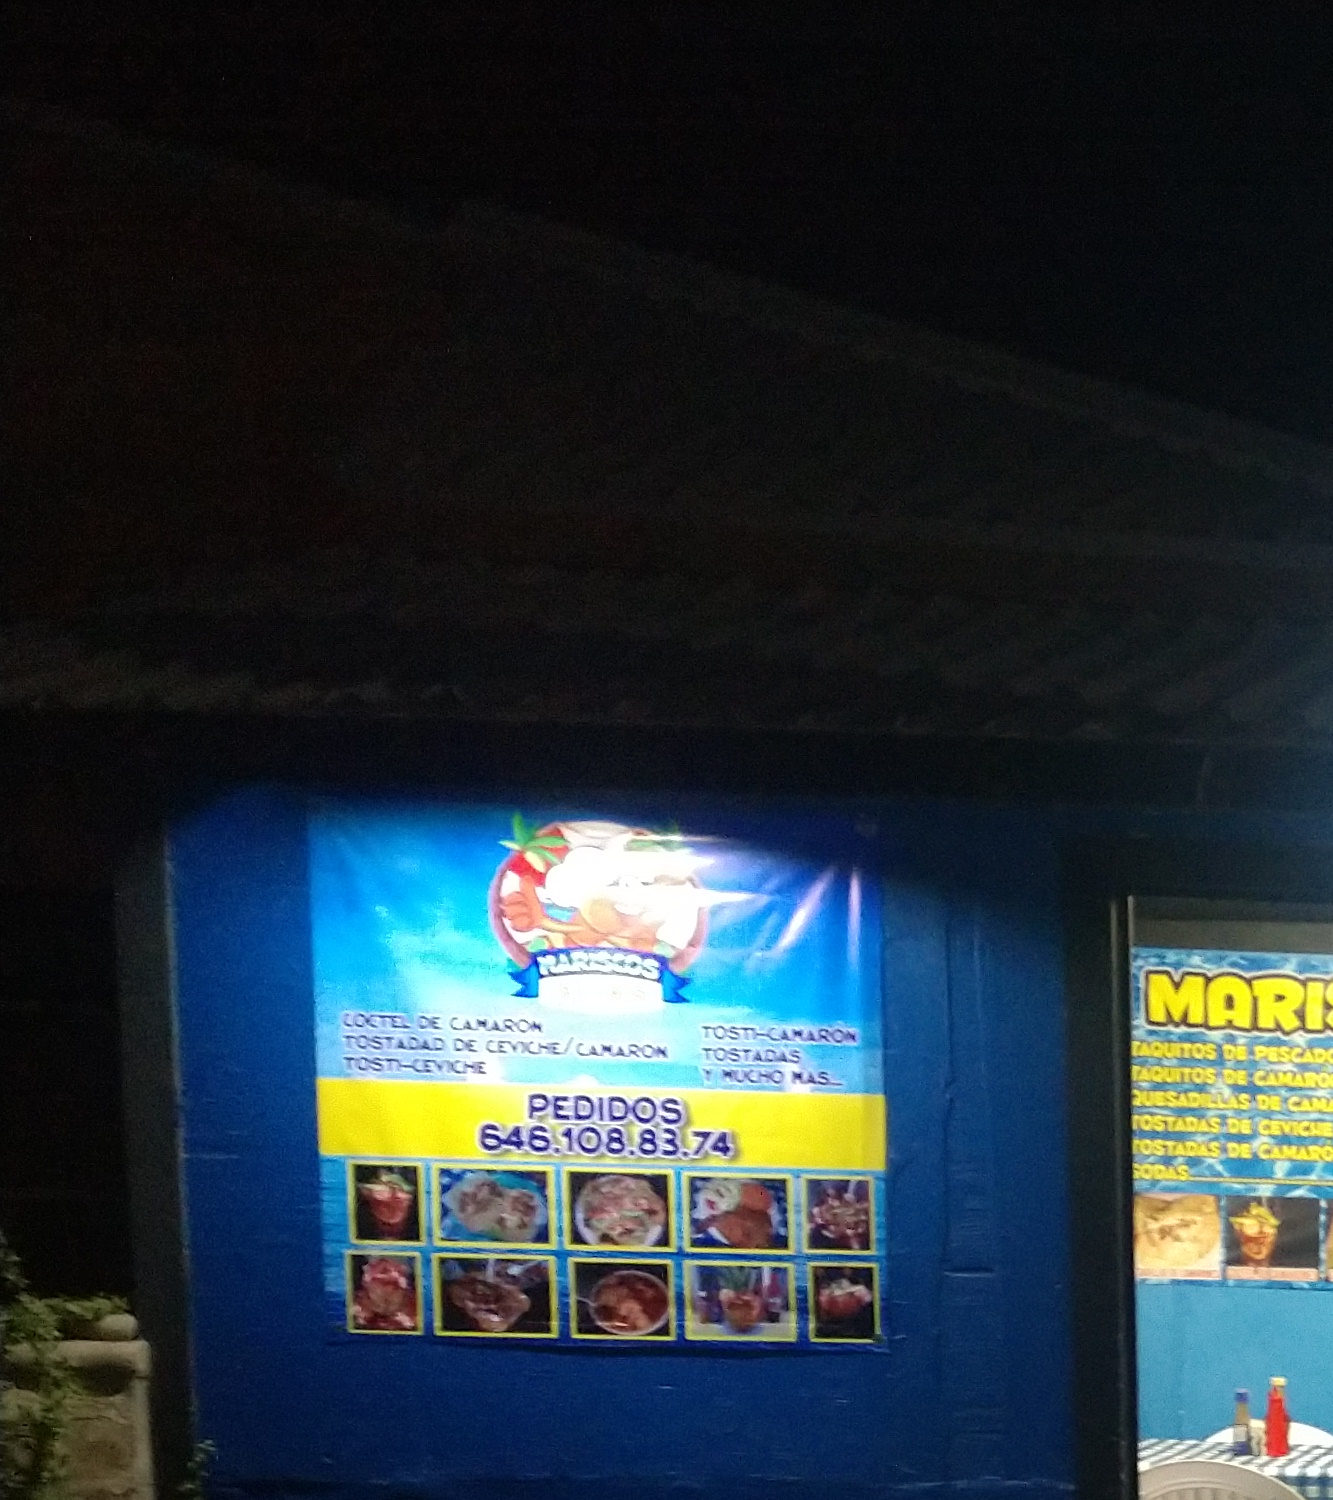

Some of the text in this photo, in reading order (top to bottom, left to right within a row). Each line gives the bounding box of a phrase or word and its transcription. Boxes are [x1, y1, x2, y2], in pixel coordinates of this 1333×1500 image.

[418, 1016, 441, 1031] DE
[453, 1038, 478, 1053] DE
[701, 1047, 801, 1064] TOSTADAS
[1131, 1041, 1218, 1060] TAQUITOS
[1222, 1044, 1248, 1061] DE
[702, 1068, 713, 1082] Y
[722, 1069, 785, 1084] MUCHO
[1131, 1065, 1218, 1085] TAQUITOS
[1222, 1069, 1248, 1086] DE
[527, 1093, 683, 1124] PEDIDOS
[1132, 1090, 1251, 1110] QUESADILLAS
[1256, 1094, 1282, 1112] DE
[1132, 1115, 1221, 1134] TOSTADAS
[1226, 1118, 1253, 1135] DE
[479, 1123, 733, 1157] 646.108.83.74
[1132, 1139, 1221, 1158] TOSTADAS
[1226, 1142, 1253, 1159] DE
[1133, 1163, 1190, 1182] SODAS
